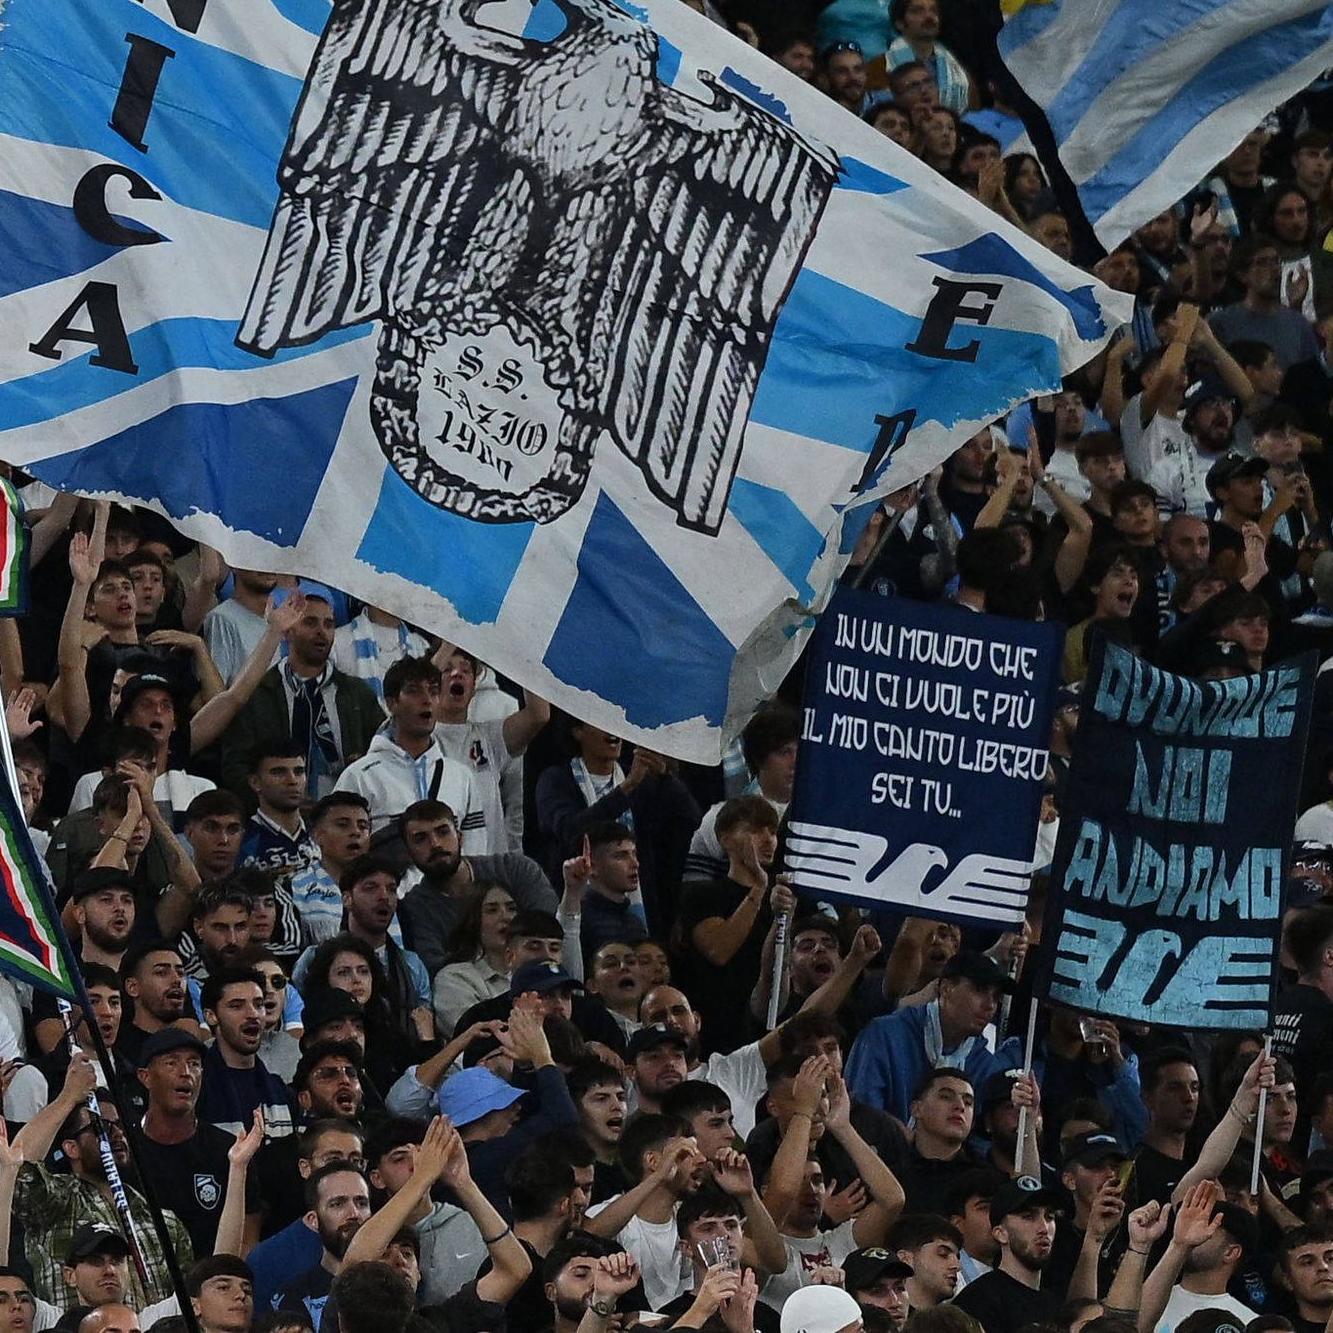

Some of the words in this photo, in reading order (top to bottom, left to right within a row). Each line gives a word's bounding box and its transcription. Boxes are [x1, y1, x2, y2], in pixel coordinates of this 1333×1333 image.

[433, 366, 548, 457] LAZIO
[834, 613, 857, 650] IN
[860, 619, 894, 657] UN
[897, 625, 984, 672] MONDO
[989, 641, 1038, 682] CHE
[825, 661, 870, 703] NON
[875, 671, 901, 709] CI
[904, 676, 990, 724] VUOLE
[991, 689, 1036, 730] PIÙ
[1093, 641, 1302, 739] OVUNQUE
[800, 707, 823, 744] IL
[828, 712, 868, 751] MIO
[873, 720, 955, 766] CANTO
[957, 735, 1049, 781] LIBERO
[1126, 738, 1233, 825] NOI
[871, 771, 915, 810] SEI
[920, 778, 962, 819] TU...
[1062, 817, 1283, 923] ANDIAMO
